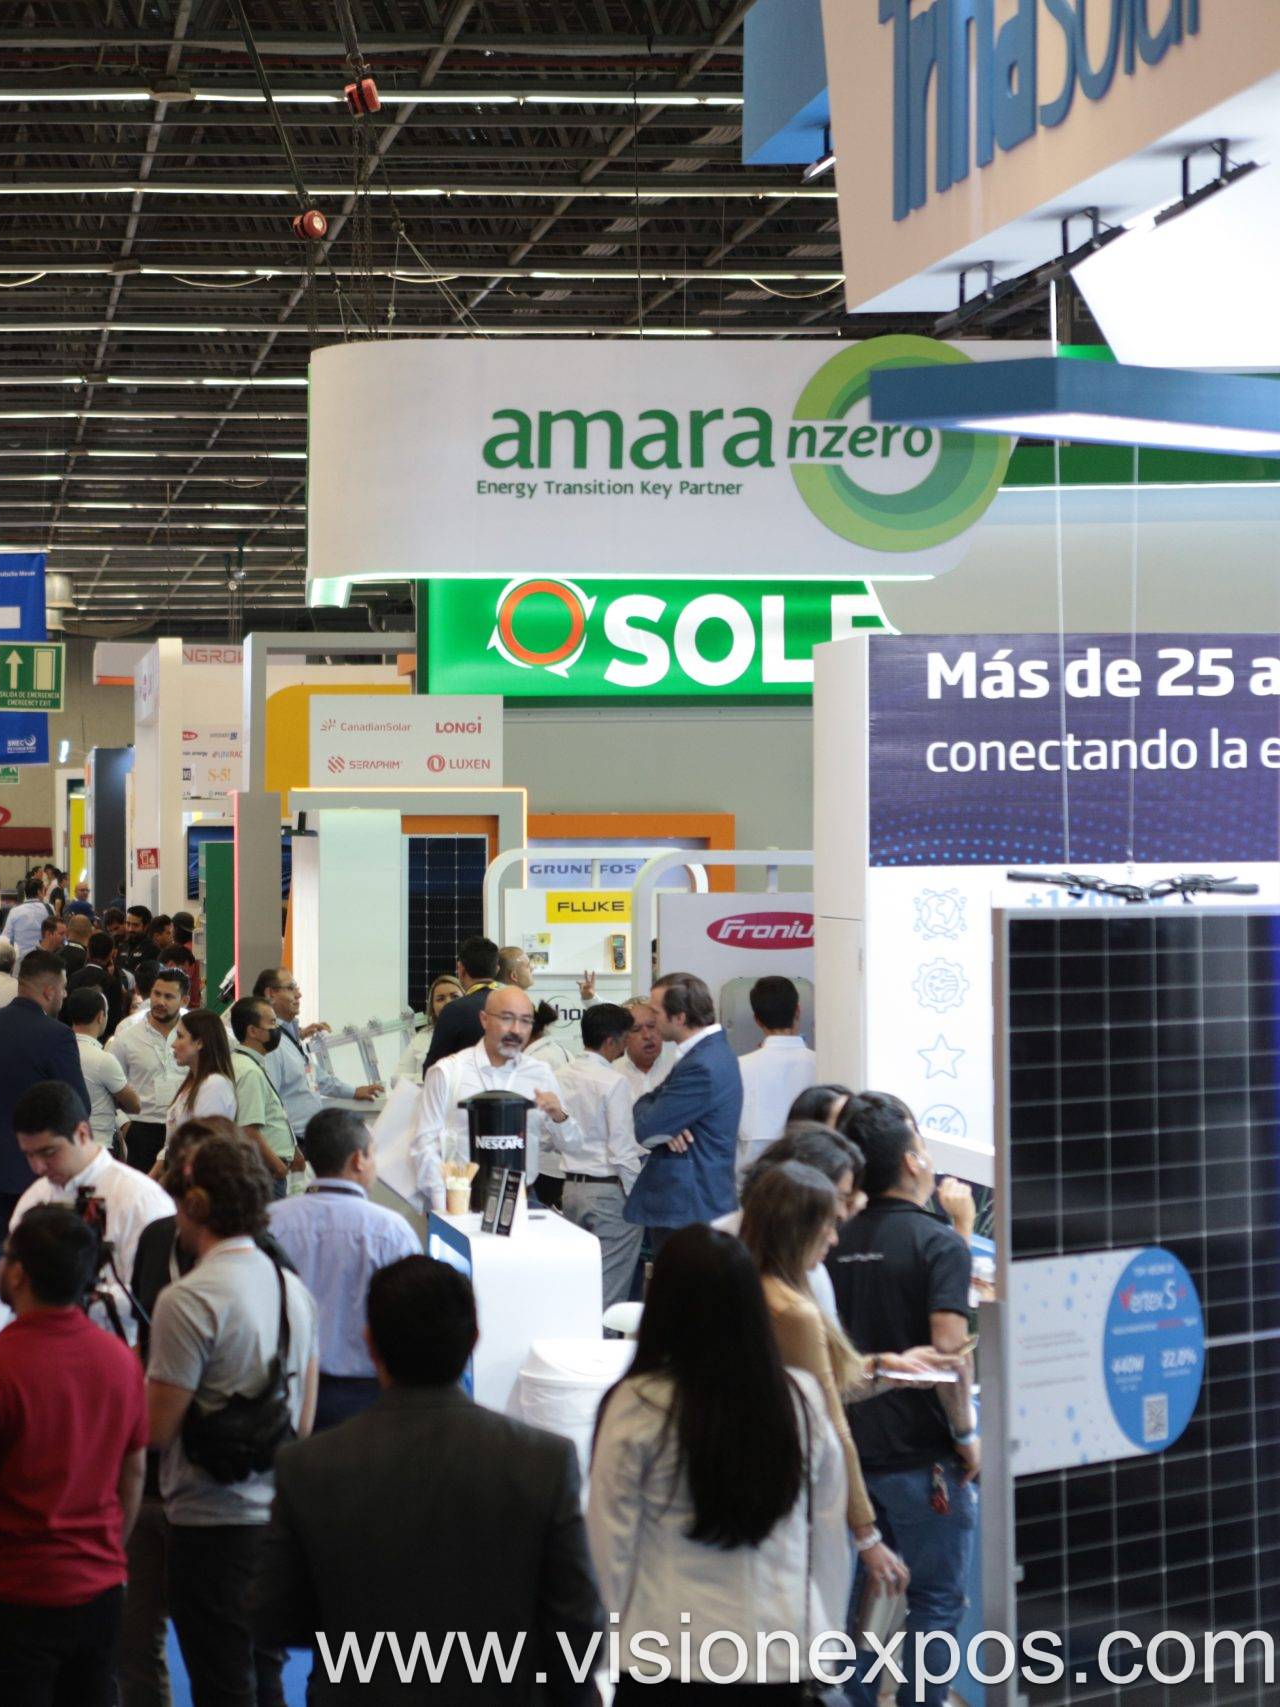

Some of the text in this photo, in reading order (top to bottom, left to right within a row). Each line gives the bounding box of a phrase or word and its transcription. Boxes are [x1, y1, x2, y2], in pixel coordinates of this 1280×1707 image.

[482, 407, 935, 470] amara nzero
[476, 479, 743, 498] Energy Transition Key Partner
[927, 649, 1050, 700] Más
[1065, 648, 1142, 698] de
[1156, 648, 1235, 697] 25
[926, 729, 1198, 772] conectando
[1211, 728, 1248, 770] la
[349, 760, 400, 770] SERAPHIM
[449, 759, 491, 770] LUXEN
[557, 900, 625, 913] FLUKE
[717, 919, 814, 940] Froniu
